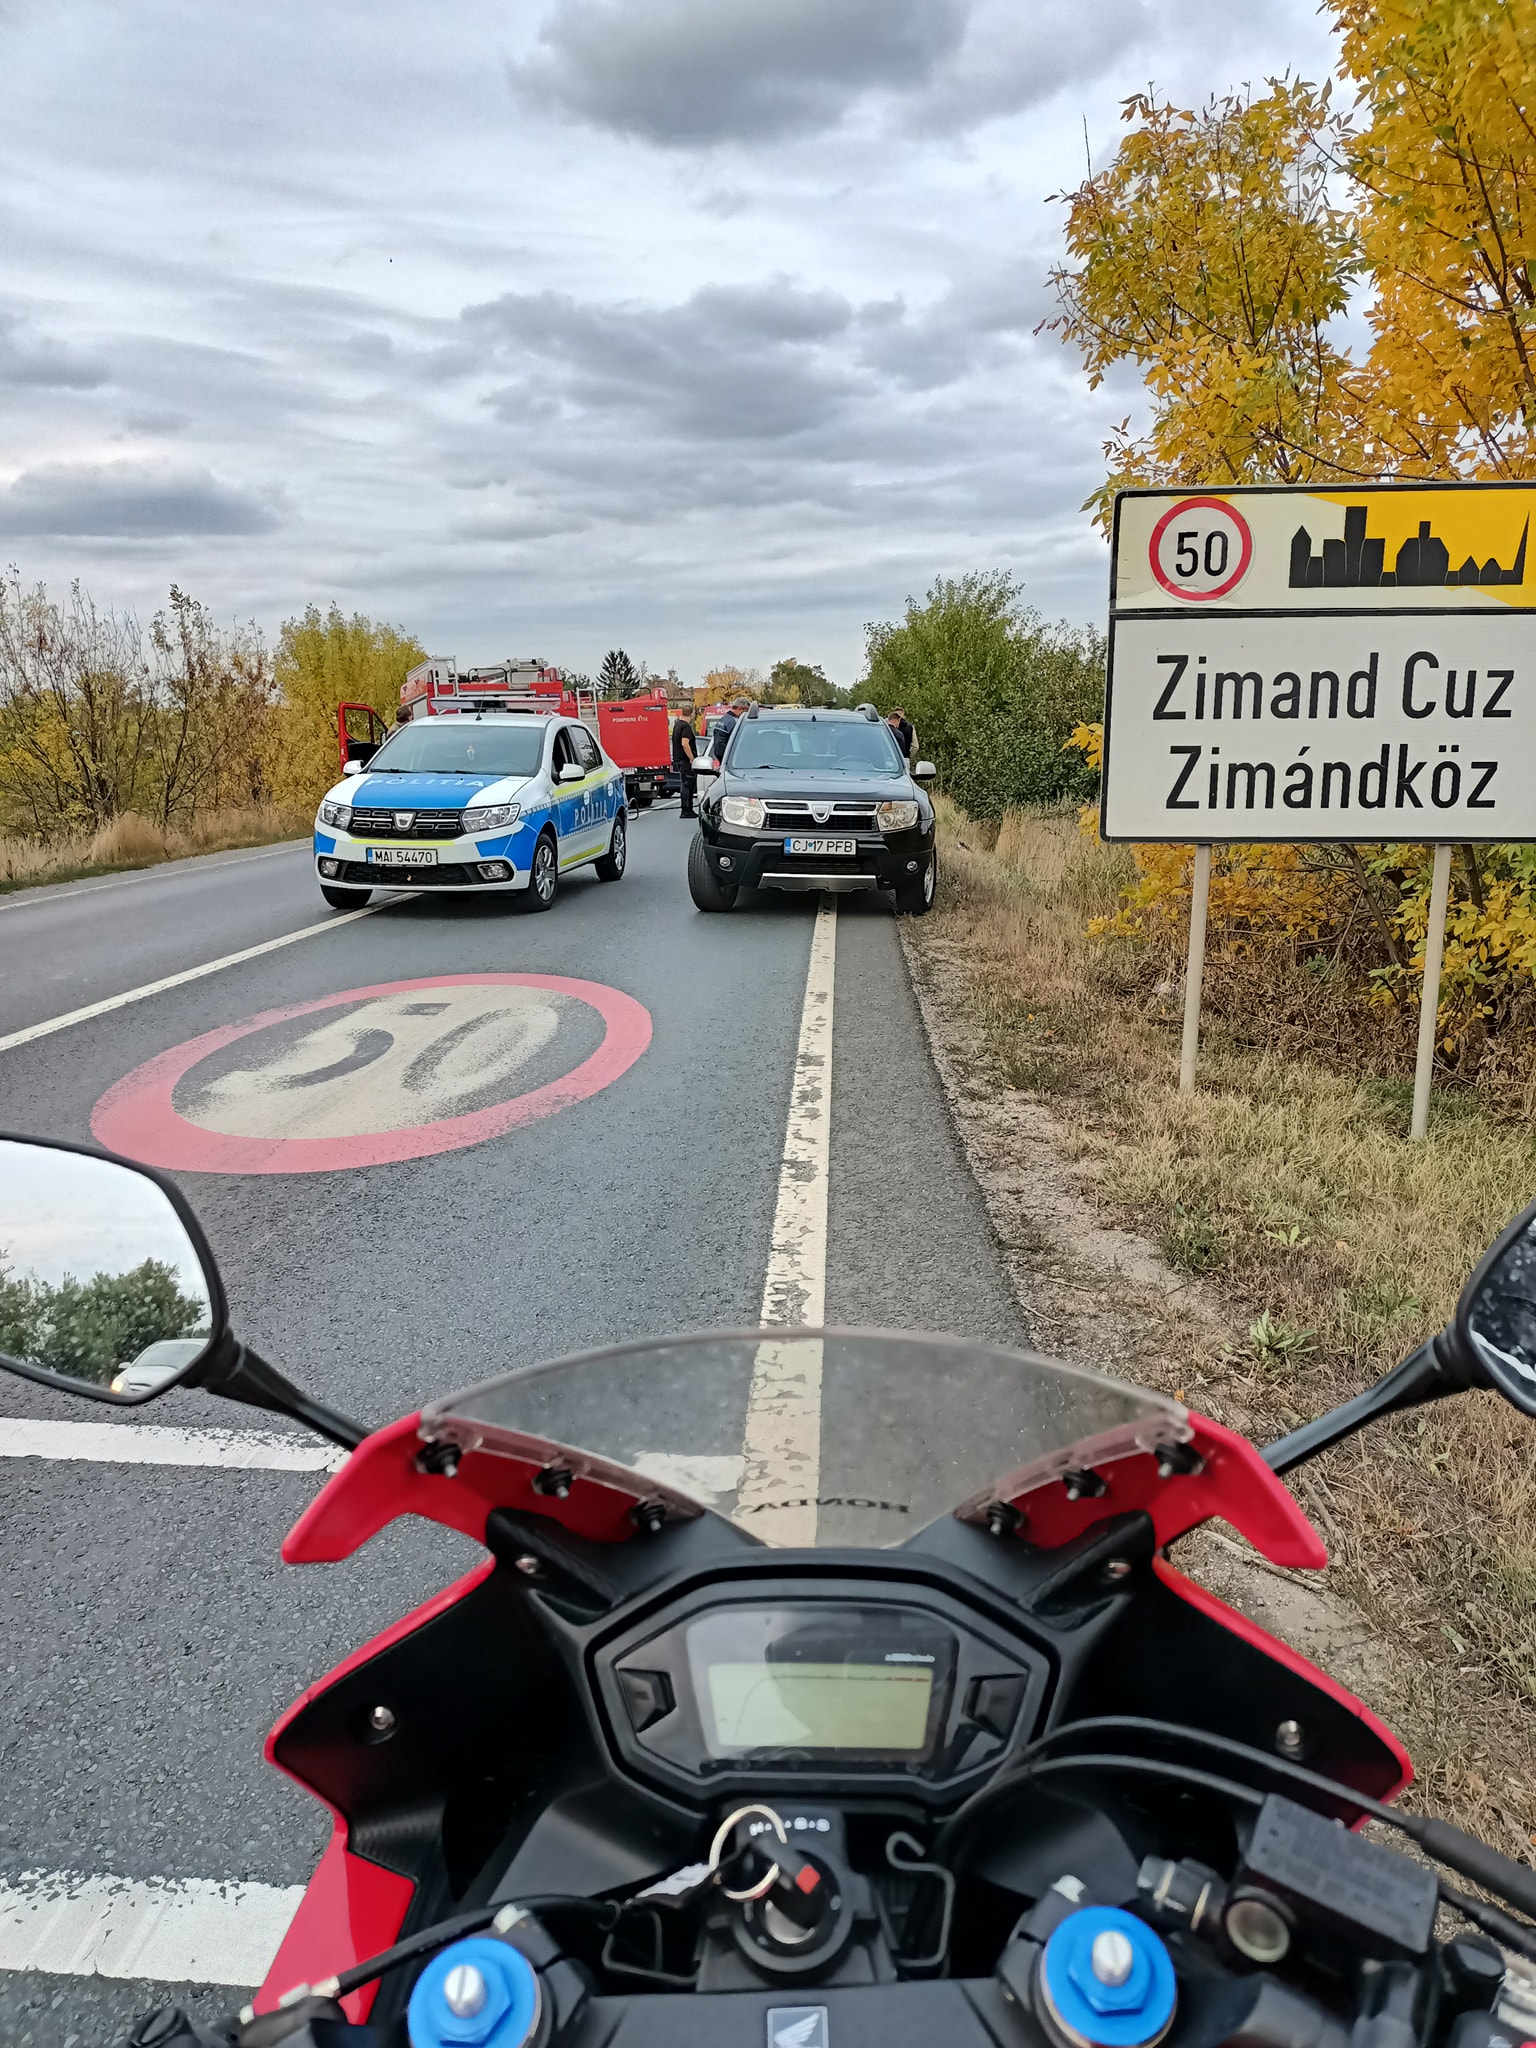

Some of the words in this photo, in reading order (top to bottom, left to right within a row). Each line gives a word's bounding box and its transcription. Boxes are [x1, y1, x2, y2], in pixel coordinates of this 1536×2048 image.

[1175, 530, 1229, 578] 50
[1153, 652, 1379, 720] Zimand
[1402, 651, 1515, 719] Cuz
[1165, 743, 1499, 809] Zimándköz
[375, 850, 393, 863] MAI
[396, 851, 433, 864] 54470
[792, 840, 808, 852] CJ
[812, 841, 824, 852] 17
[826, 841, 853, 853] PFB
